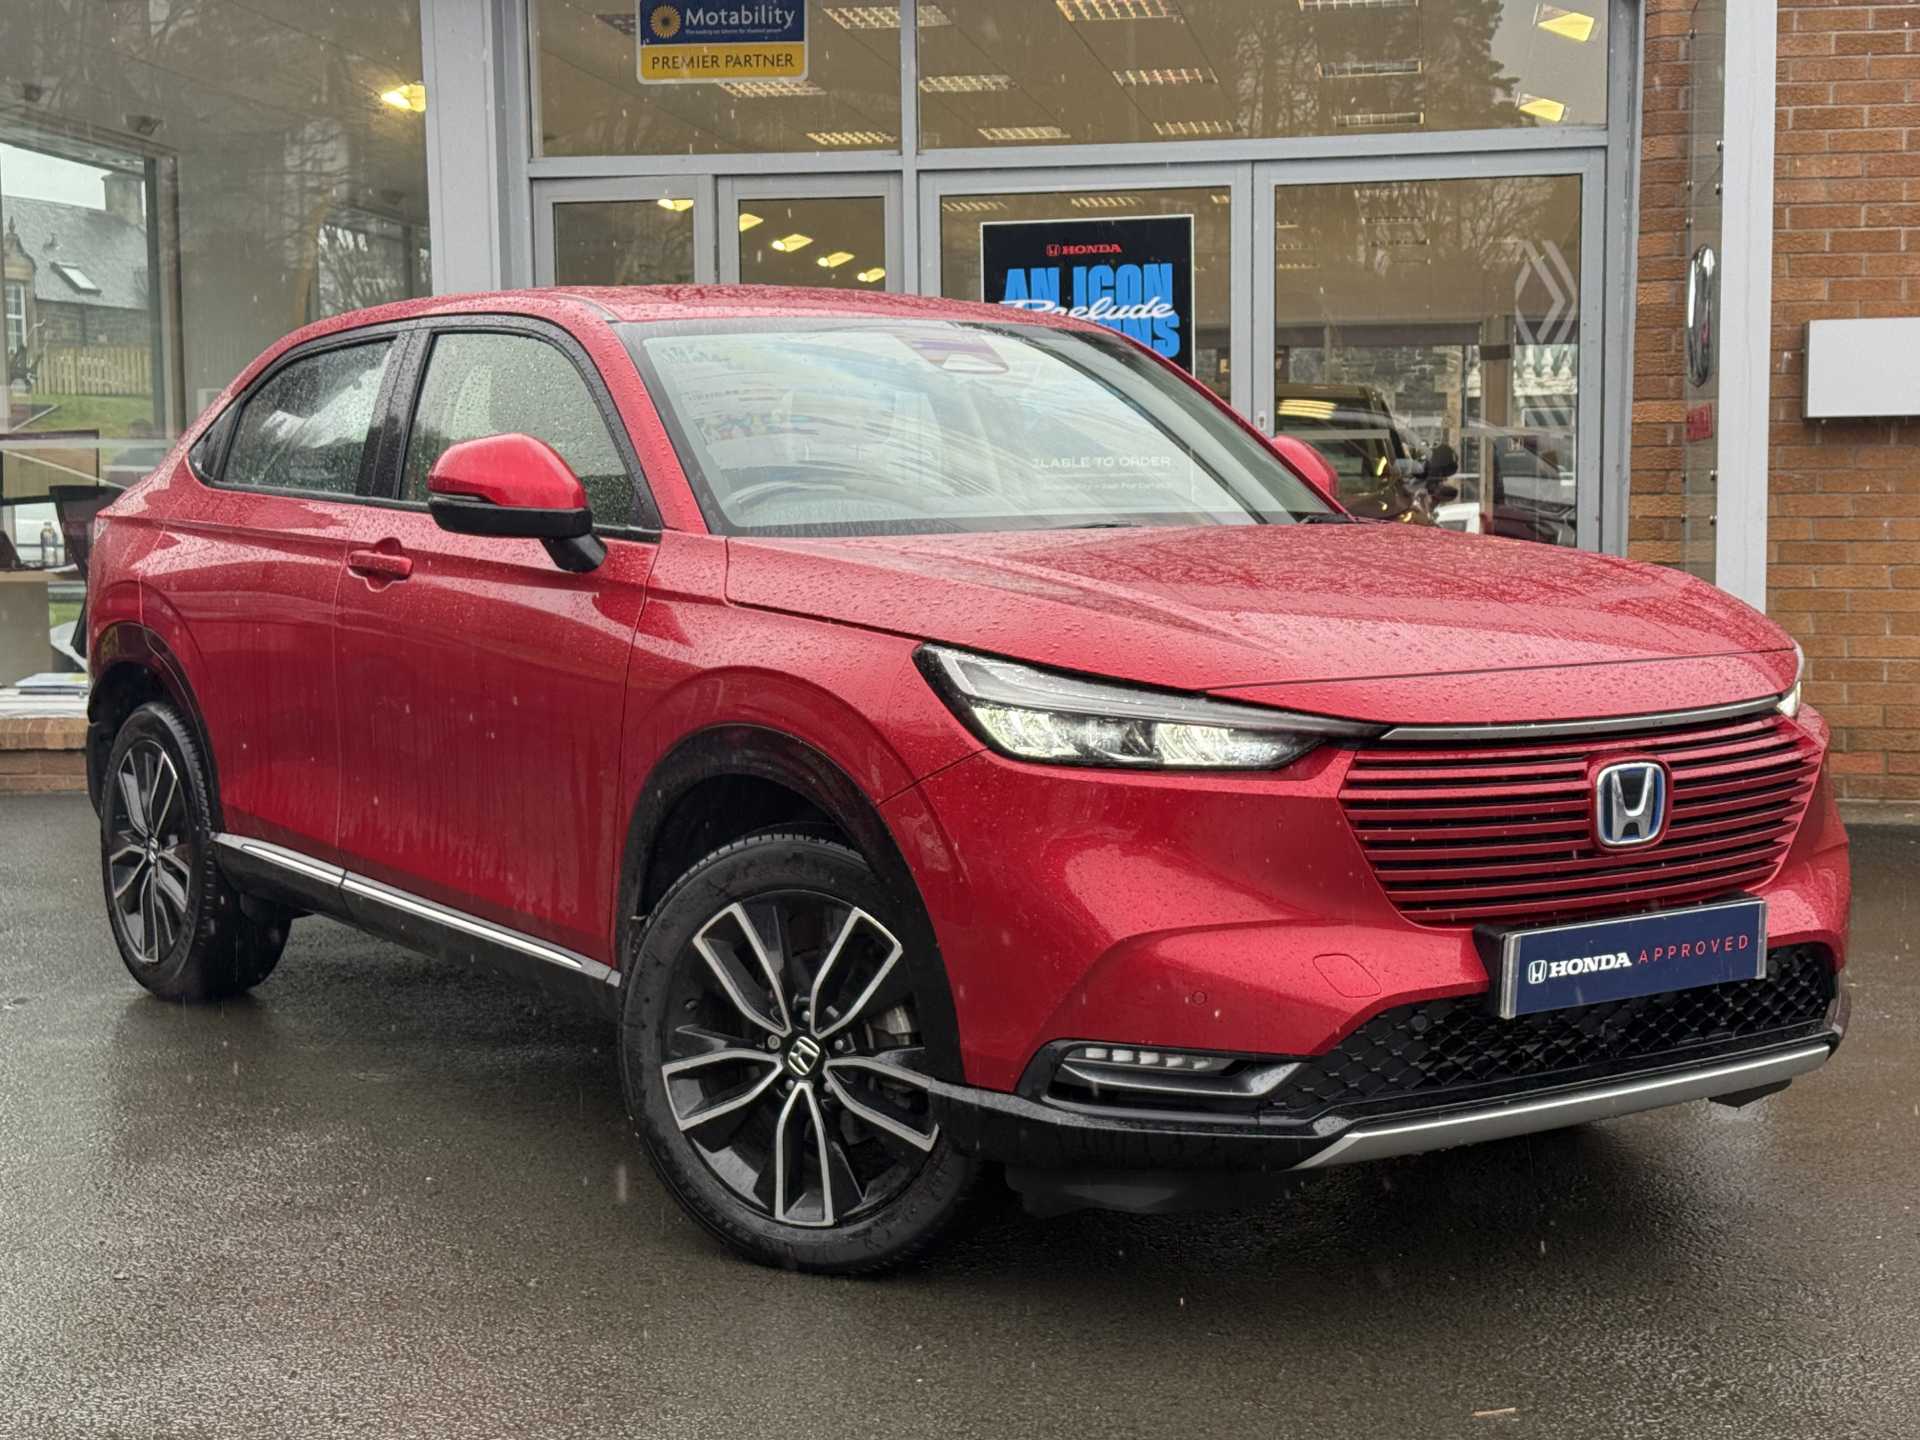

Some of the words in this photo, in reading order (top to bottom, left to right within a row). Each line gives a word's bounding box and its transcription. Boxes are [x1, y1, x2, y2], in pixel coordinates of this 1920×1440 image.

[685, 5, 795, 29] Motability
[652, 54, 720, 69] PREMIER
[725, 53, 795, 68] PARTNER
[1062, 244, 1122, 255] HONDA
[1004, 267, 1060, 309] AN
[1073, 263, 1173, 314] ICON
[1119, 455, 1171, 468] ORDER
[1549, 952, 1632, 978] HONDA
[1638, 934, 1748, 964] APPROVED
